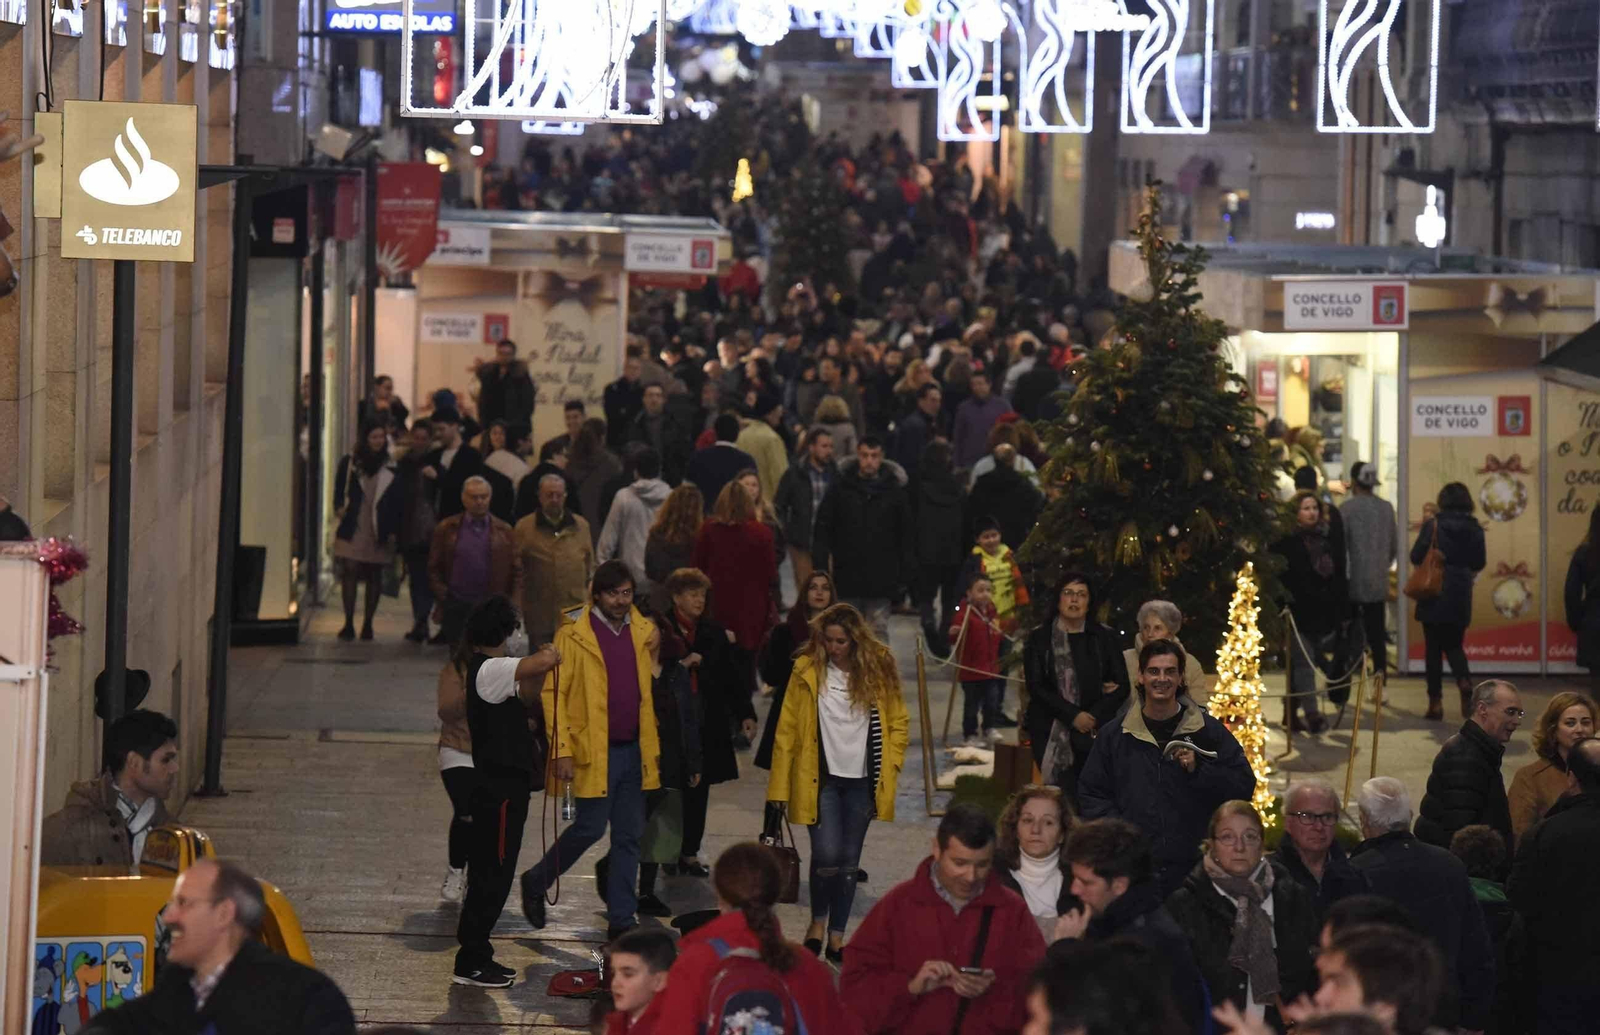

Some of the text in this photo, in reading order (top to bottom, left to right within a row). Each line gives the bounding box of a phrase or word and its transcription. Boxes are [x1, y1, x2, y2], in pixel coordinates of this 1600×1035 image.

[329, 13, 453, 31] AUTO ESOLAS
[102, 227, 182, 247] TELEBANCO
[1292, 293, 1362, 305] CONCELLO
[1301, 306, 1354, 318] DE VIGO
[1416, 404, 1488, 415] CONCELLO
[1425, 417, 1479, 429] DE VIGO
[1557, 441, 1571, 457] o
[1557, 486, 1585, 514] da
